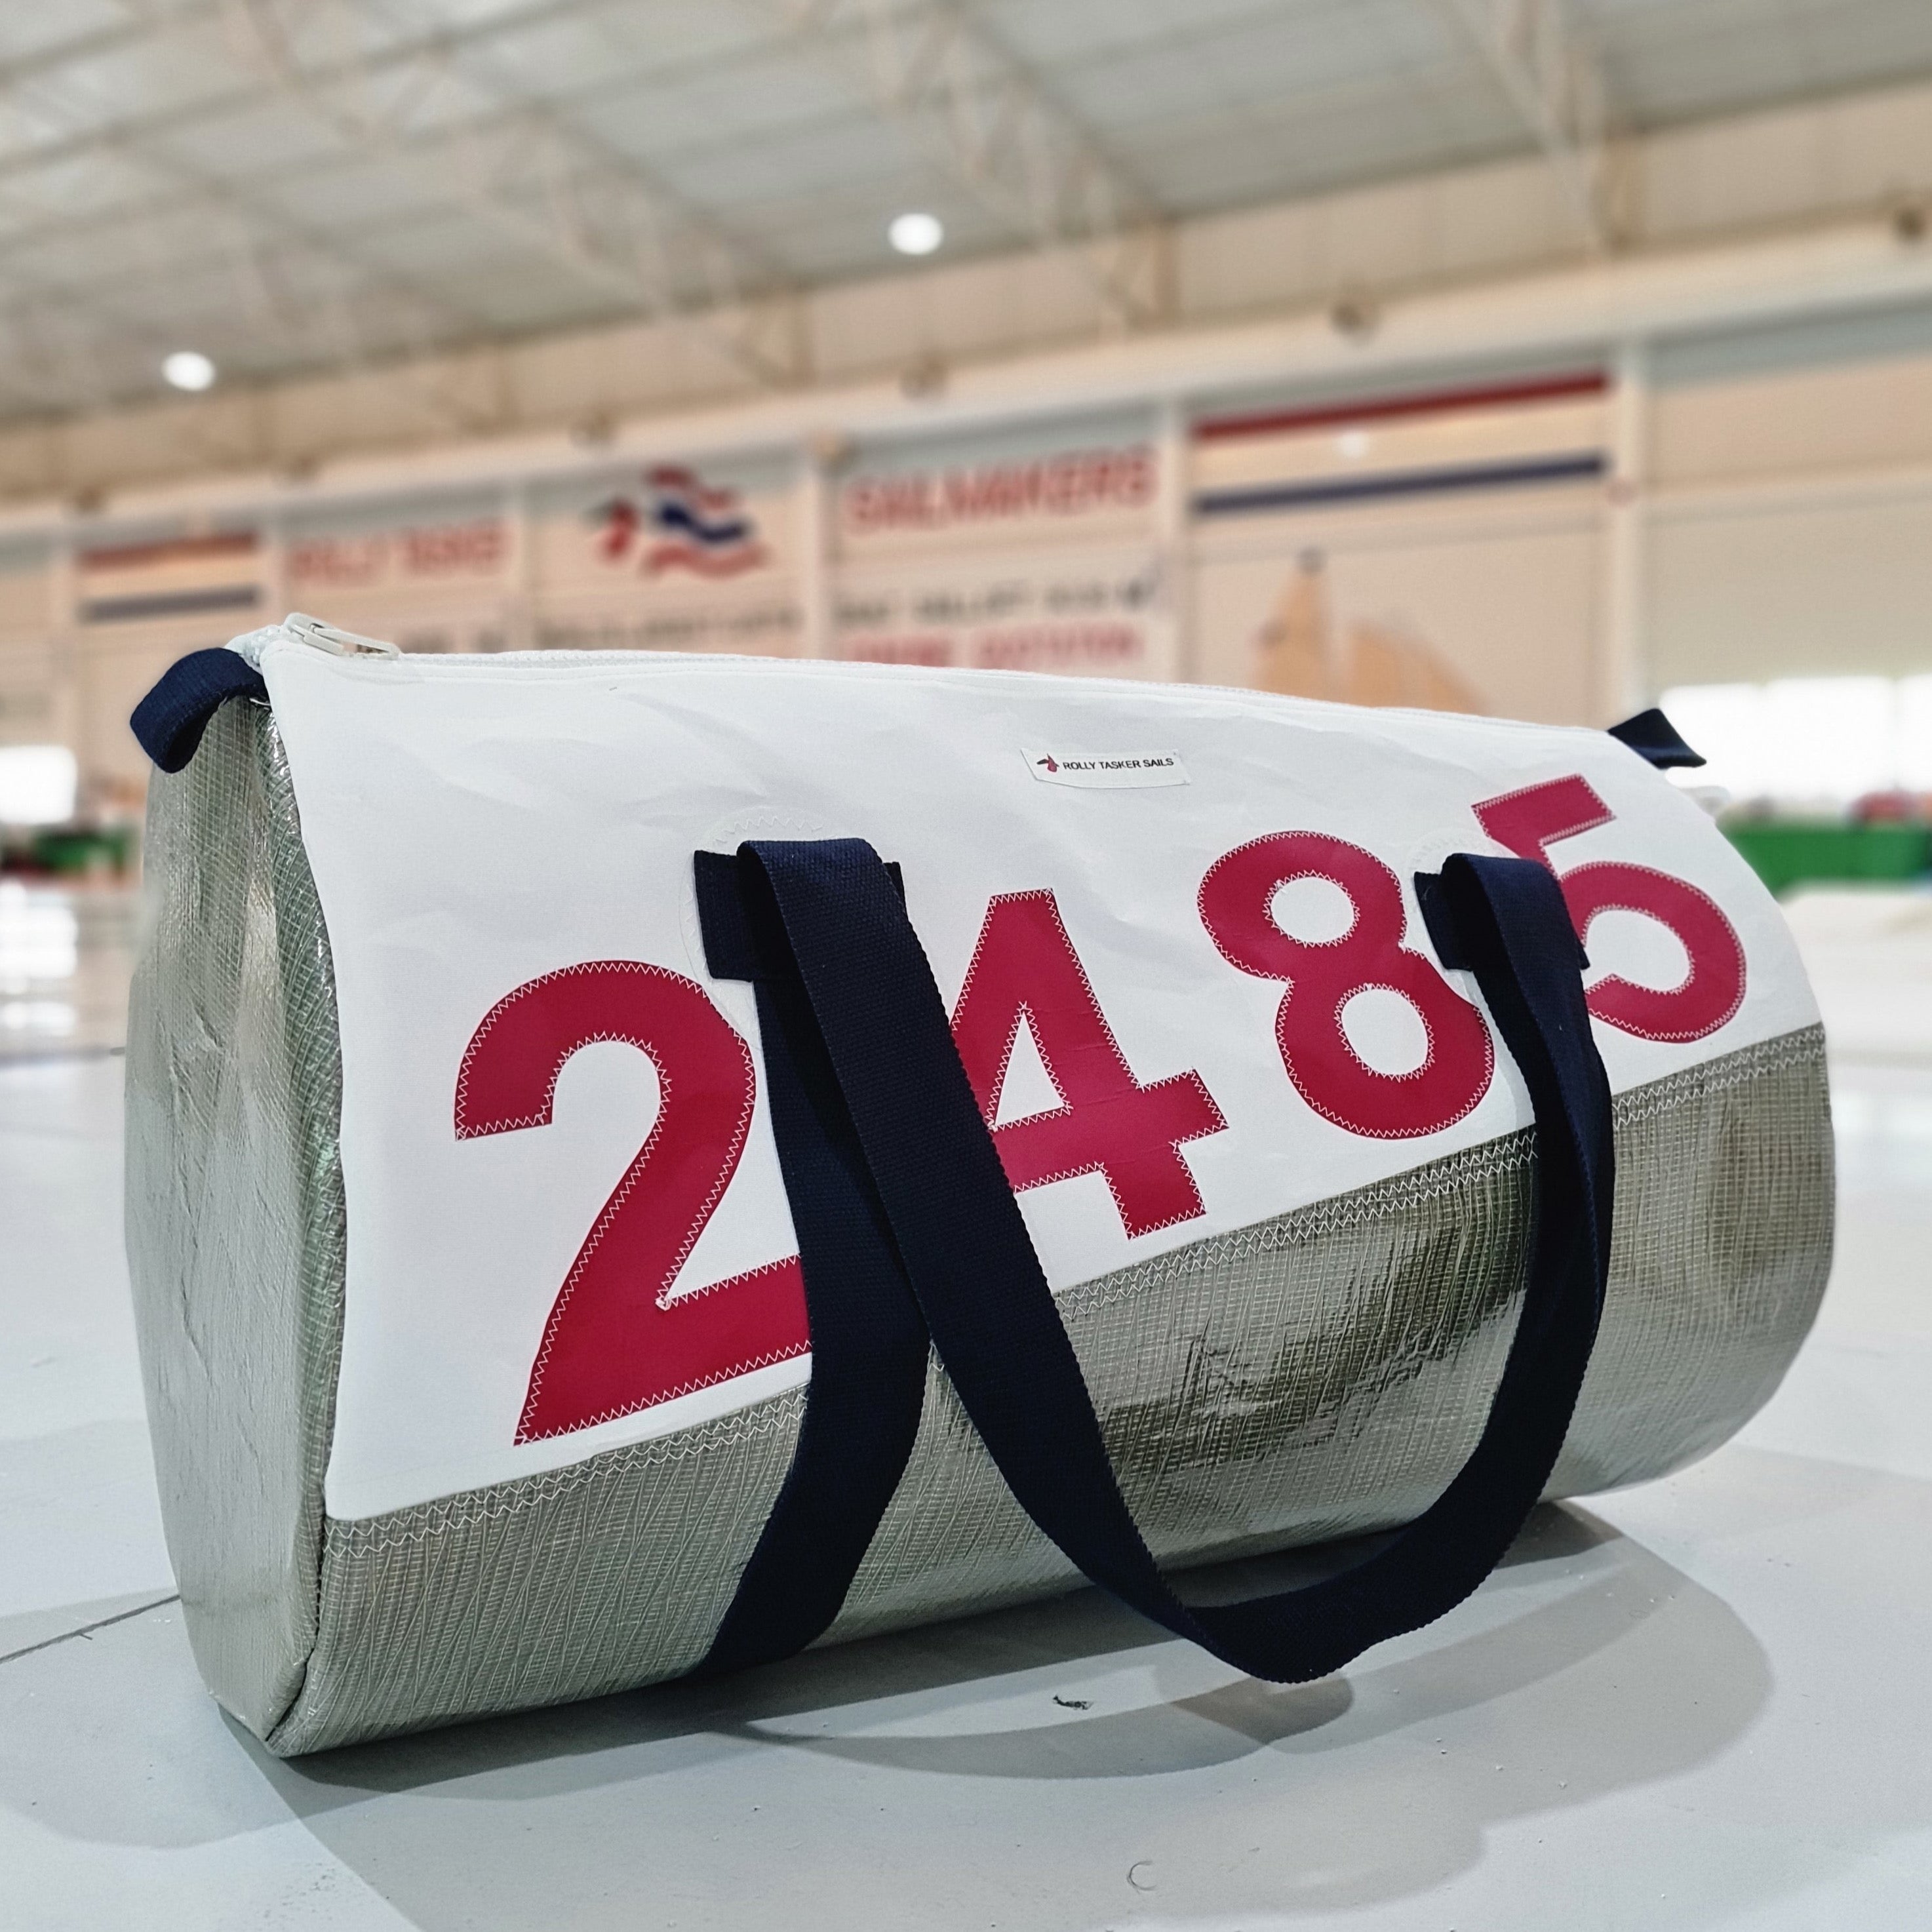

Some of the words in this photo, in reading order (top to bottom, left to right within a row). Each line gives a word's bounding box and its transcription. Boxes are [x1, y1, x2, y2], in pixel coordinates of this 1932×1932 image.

[1063, 761, 1096, 770] ROLLY
[1098, 759, 1141, 770] TASKER
[1143, 757, 1174, 767] SAILS
